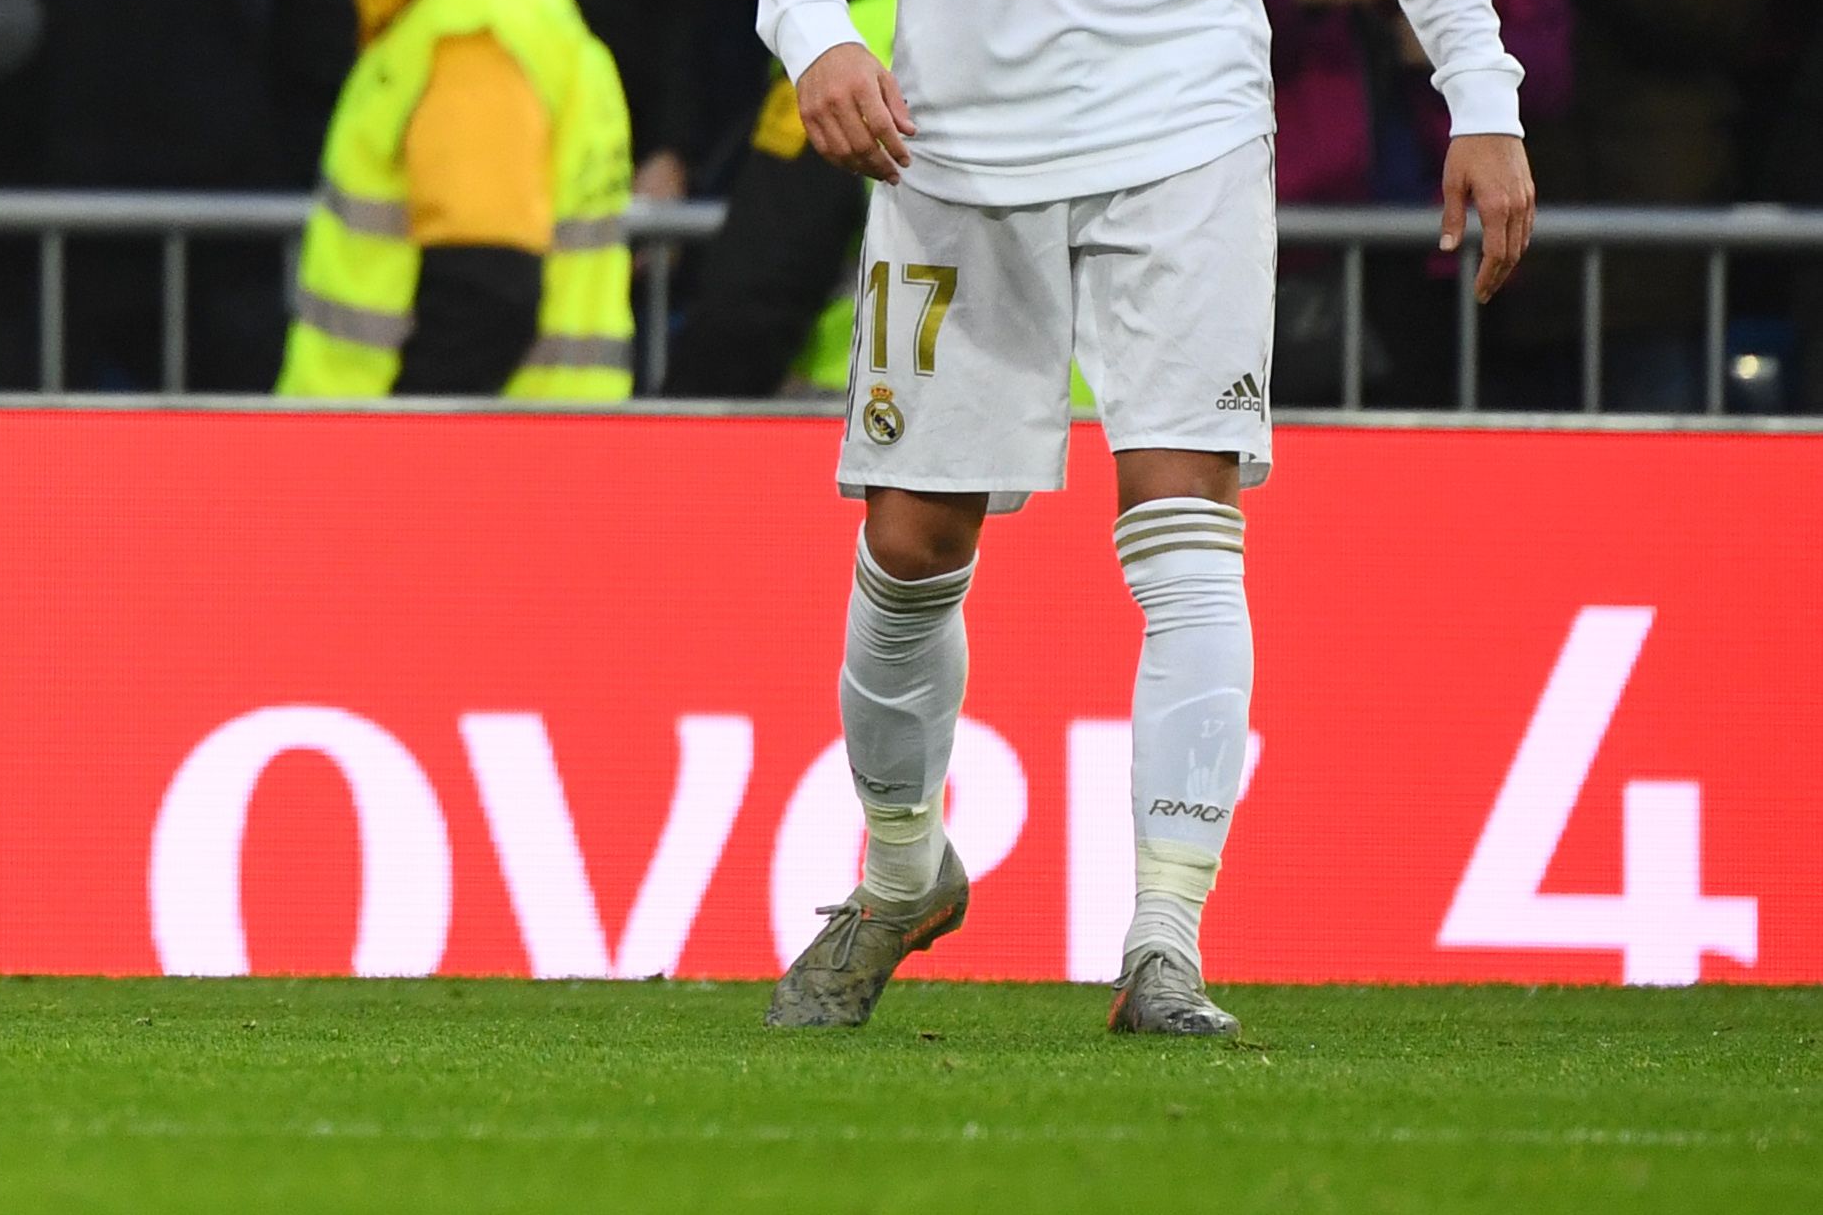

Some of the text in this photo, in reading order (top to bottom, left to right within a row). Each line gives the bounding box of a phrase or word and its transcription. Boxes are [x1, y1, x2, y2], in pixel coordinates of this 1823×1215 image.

[865, 260, 958, 378] 17
[1215, 396, 1262, 413] adida
[1148, 798, 1230, 822] RMCF
[1435, 605, 1759, 986] 4
